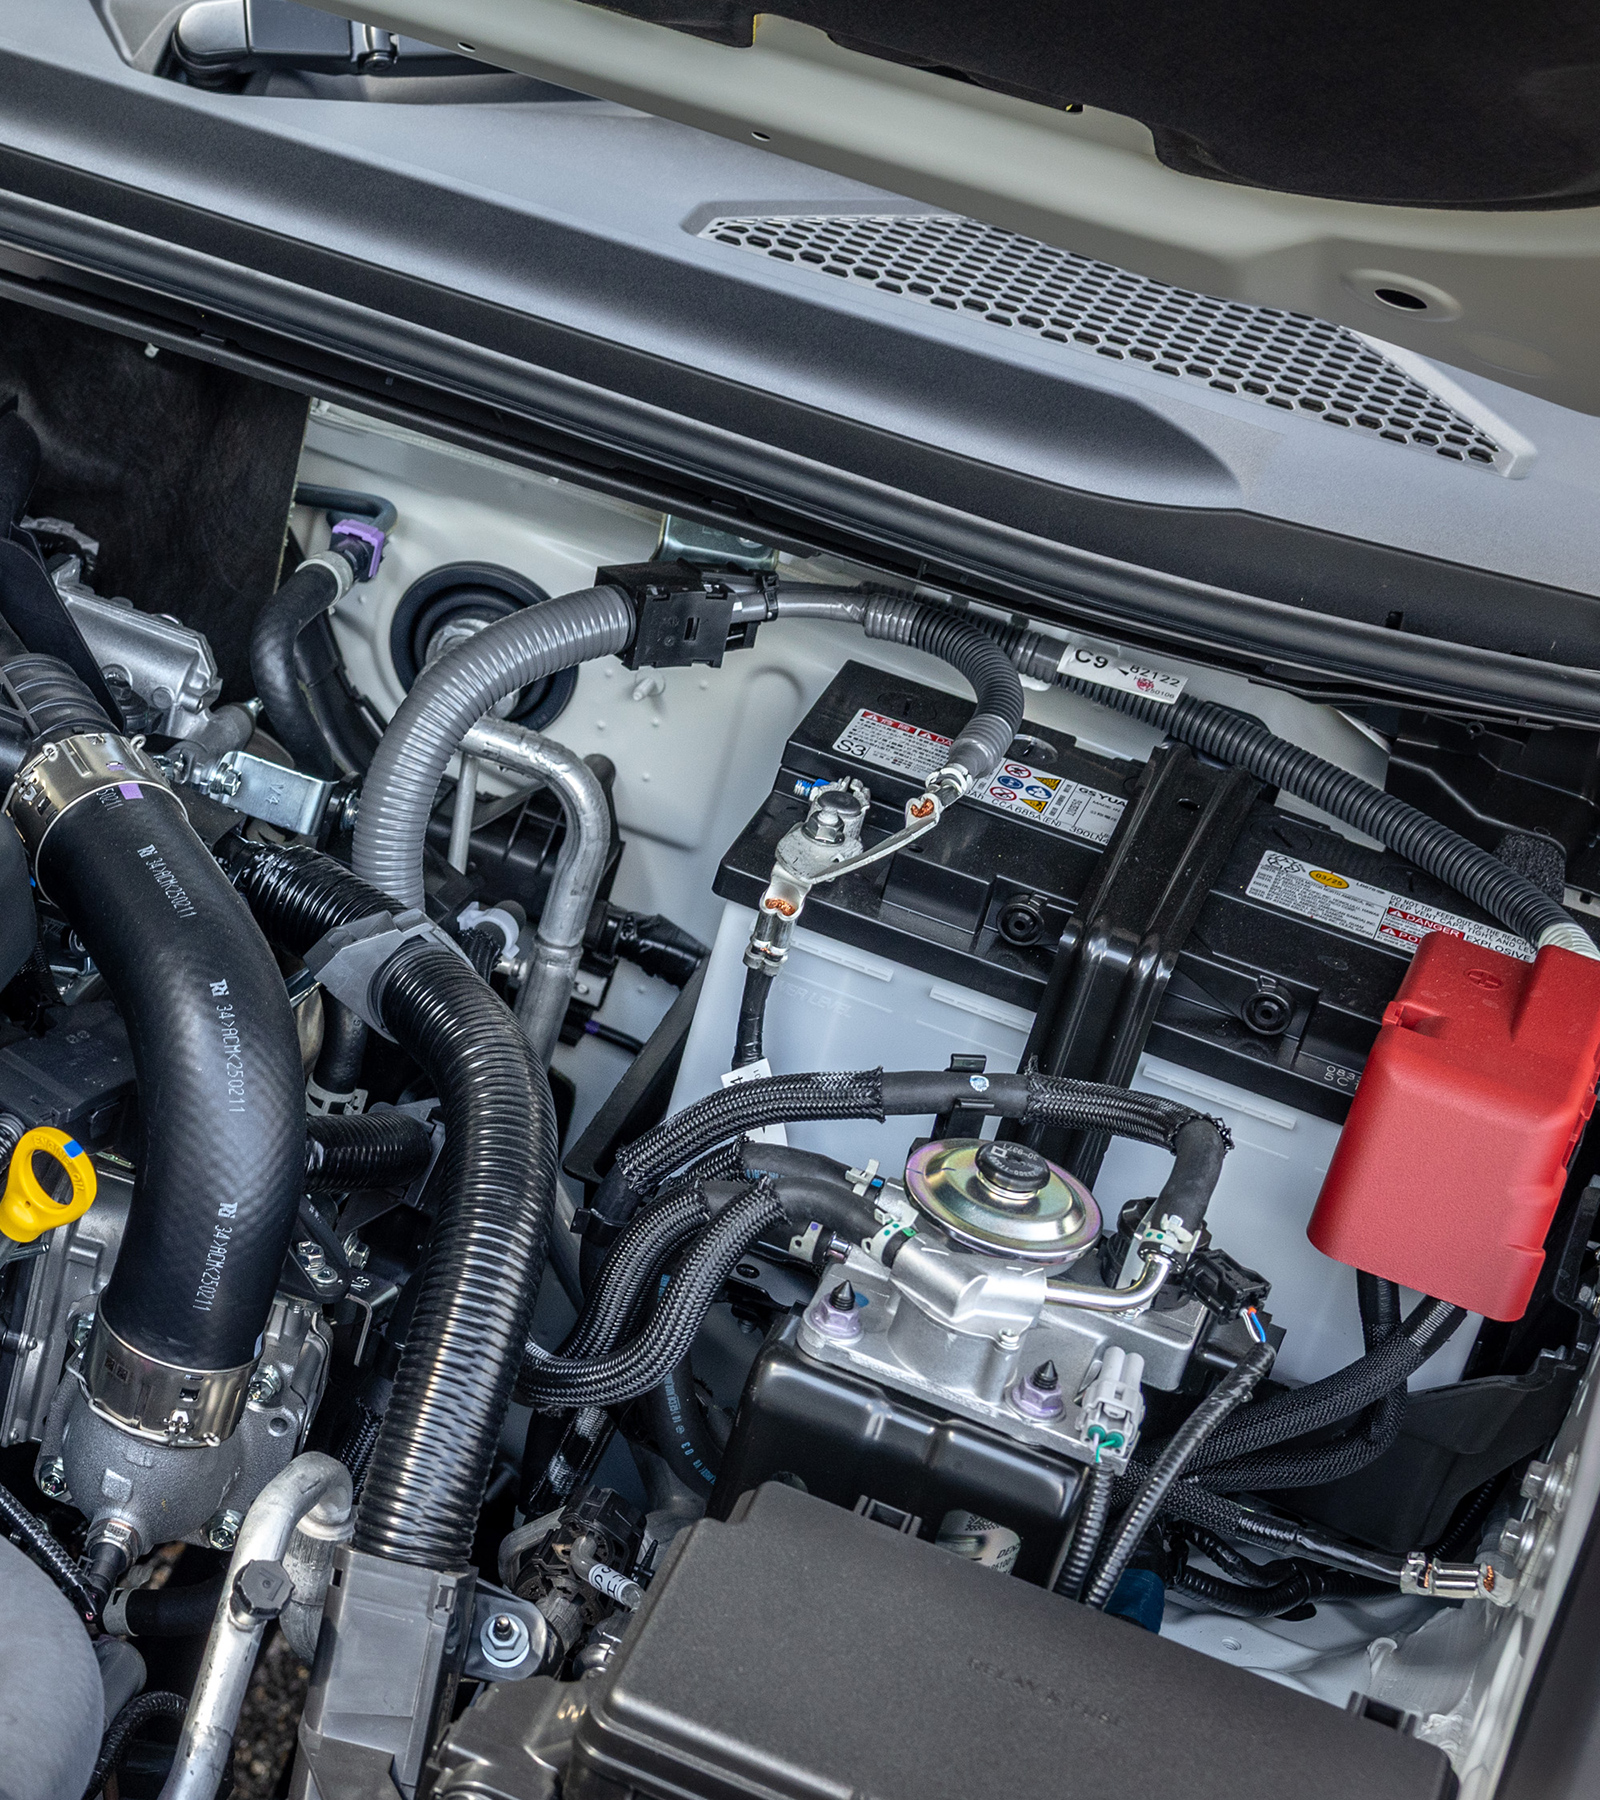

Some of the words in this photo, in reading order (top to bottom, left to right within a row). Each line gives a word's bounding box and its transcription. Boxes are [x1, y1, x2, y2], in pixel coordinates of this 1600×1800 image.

[1075, 648, 1109, 669] C9
[837, 739, 867, 757] S3
[1315, 872, 1343, 887] 03/25
[1406, 914, 1460, 938] DANGER
